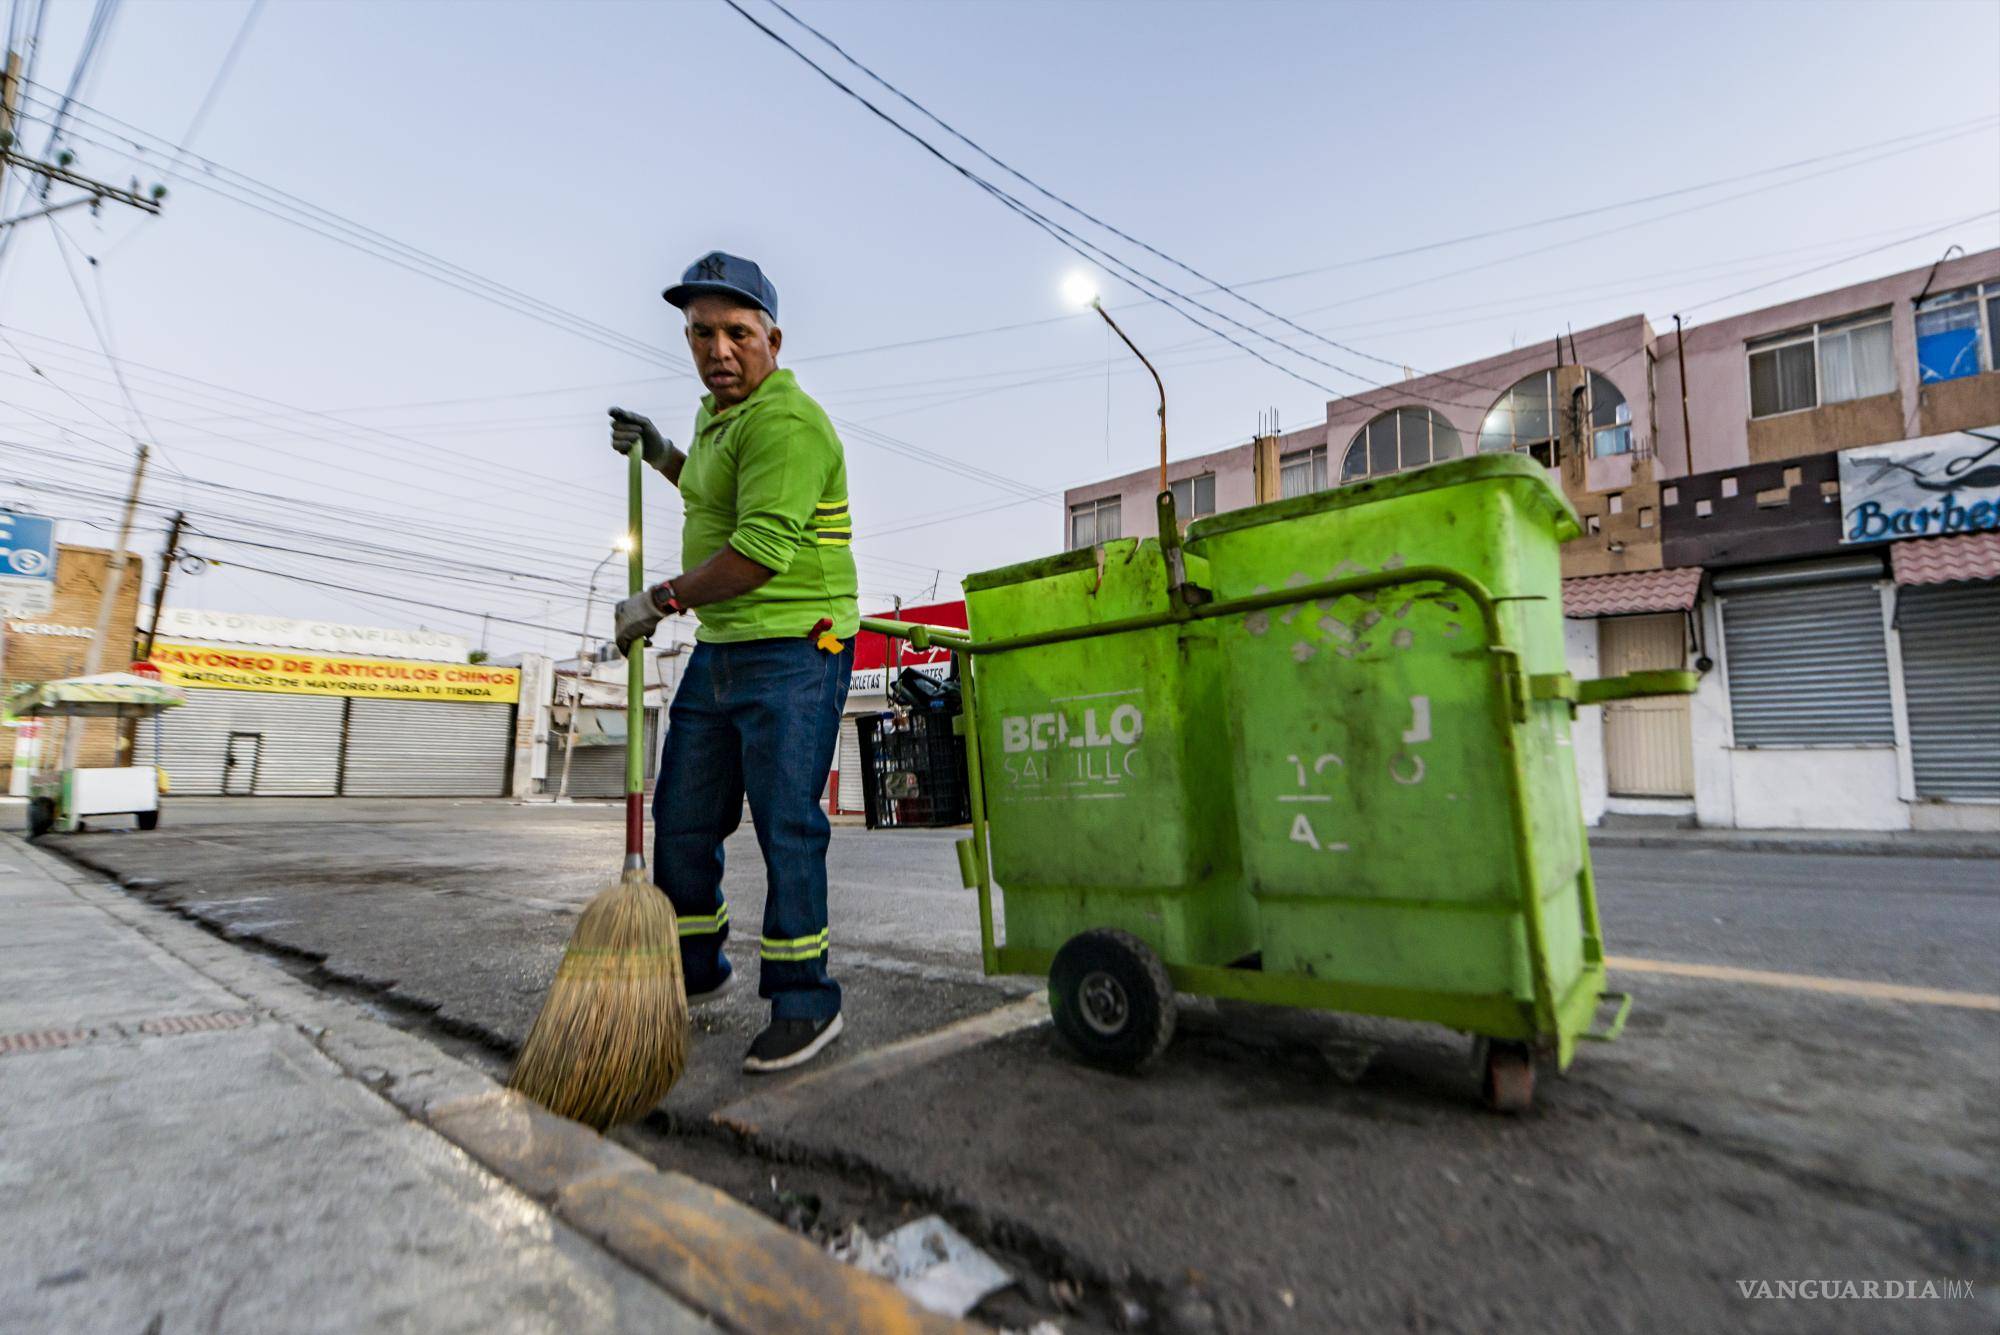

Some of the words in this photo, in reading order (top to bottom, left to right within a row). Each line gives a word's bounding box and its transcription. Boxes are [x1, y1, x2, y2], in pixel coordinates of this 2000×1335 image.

[181, 671, 273, 686] ARTICULOS
[278, 677, 299, 687] DE
[305, 679, 378, 691] MAYOREO
[383, 683, 420, 694] PARA
[426, 685, 440, 695] TU
[445, 687, 491, 697] TIENDA
[282, 659, 313, 674] DE
[322, 662, 439, 681] ARTICULOS
[445, 669, 515, 685] CHINOS
[1002, 703, 1143, 752] BELLO
